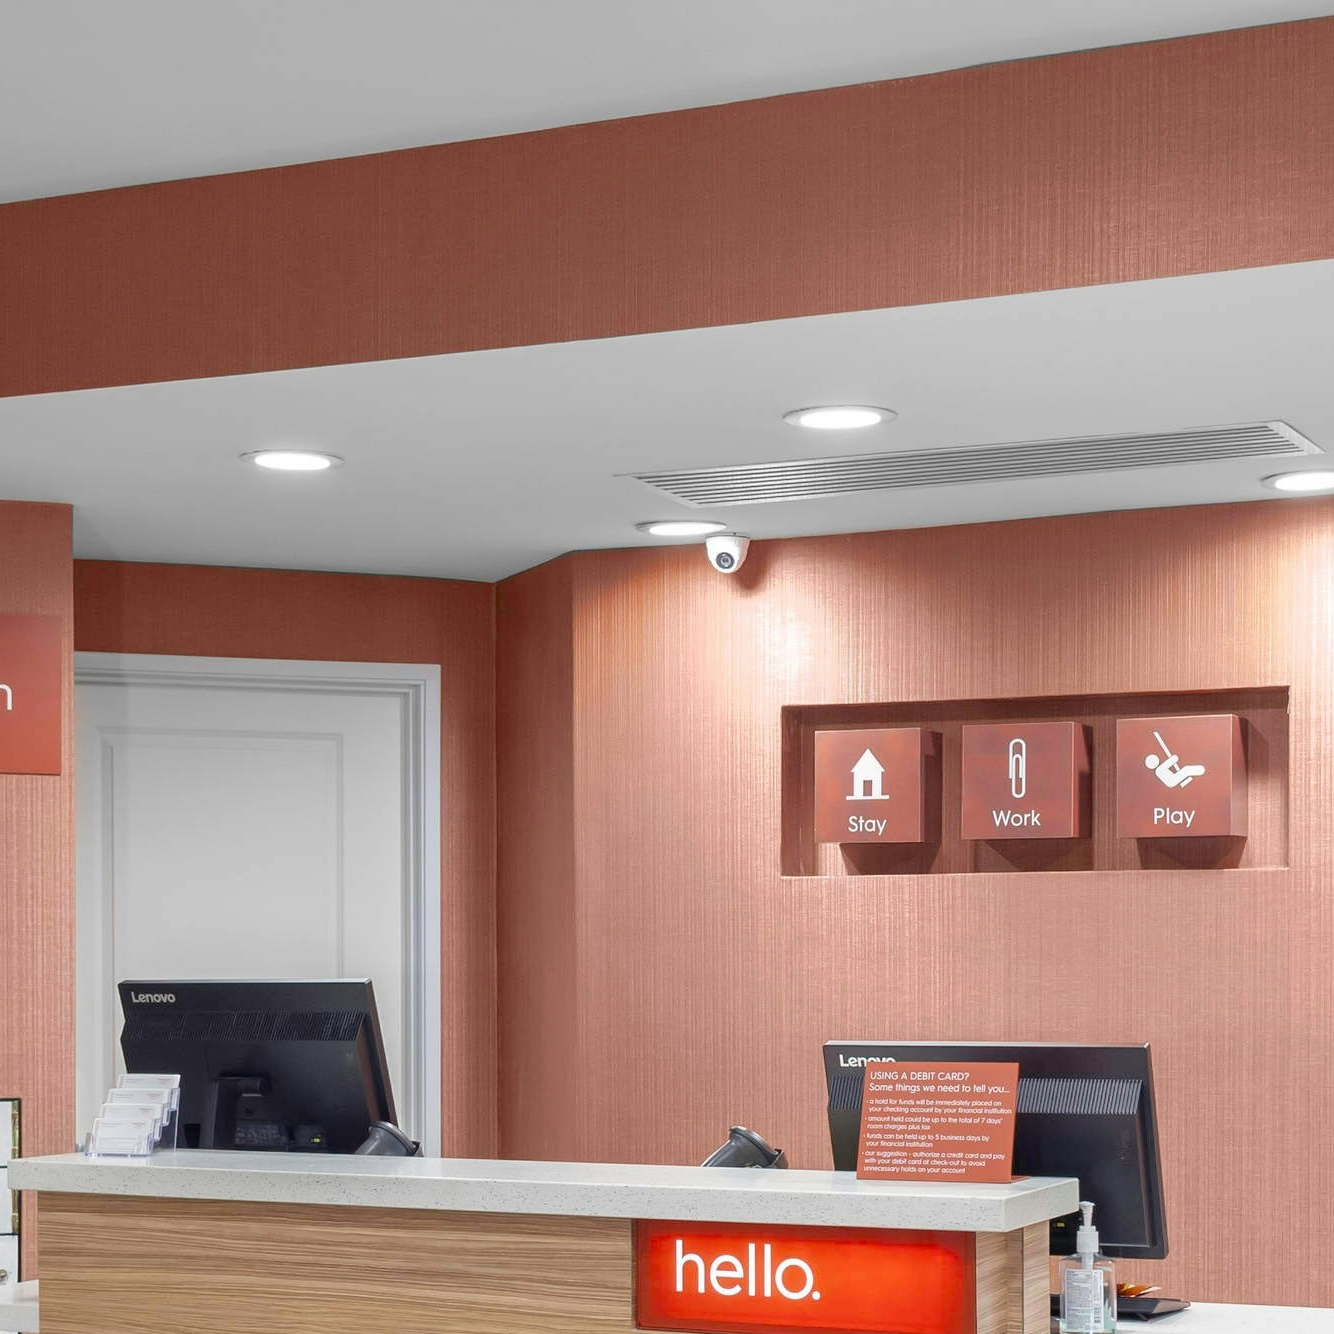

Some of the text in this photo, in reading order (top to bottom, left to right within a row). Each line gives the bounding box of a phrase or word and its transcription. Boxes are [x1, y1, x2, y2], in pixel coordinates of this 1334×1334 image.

[848, 816, 886, 835] Stay
[993, 810, 1040, 826] Work
[1154, 808, 1195, 827] Play
[131, 992, 175, 1003] Lenovo
[870, 1072, 969, 1080] USING A DEBIT CARD?
[869, 1083, 893, 1091] Some
[896, 1083, 920, 1093] things
[937, 1084, 960, 1092] need
[962, 1084, 971, 1092] to
[973, 1084, 986, 1092] tell
[676, 1240, 820, 1300] hello.
